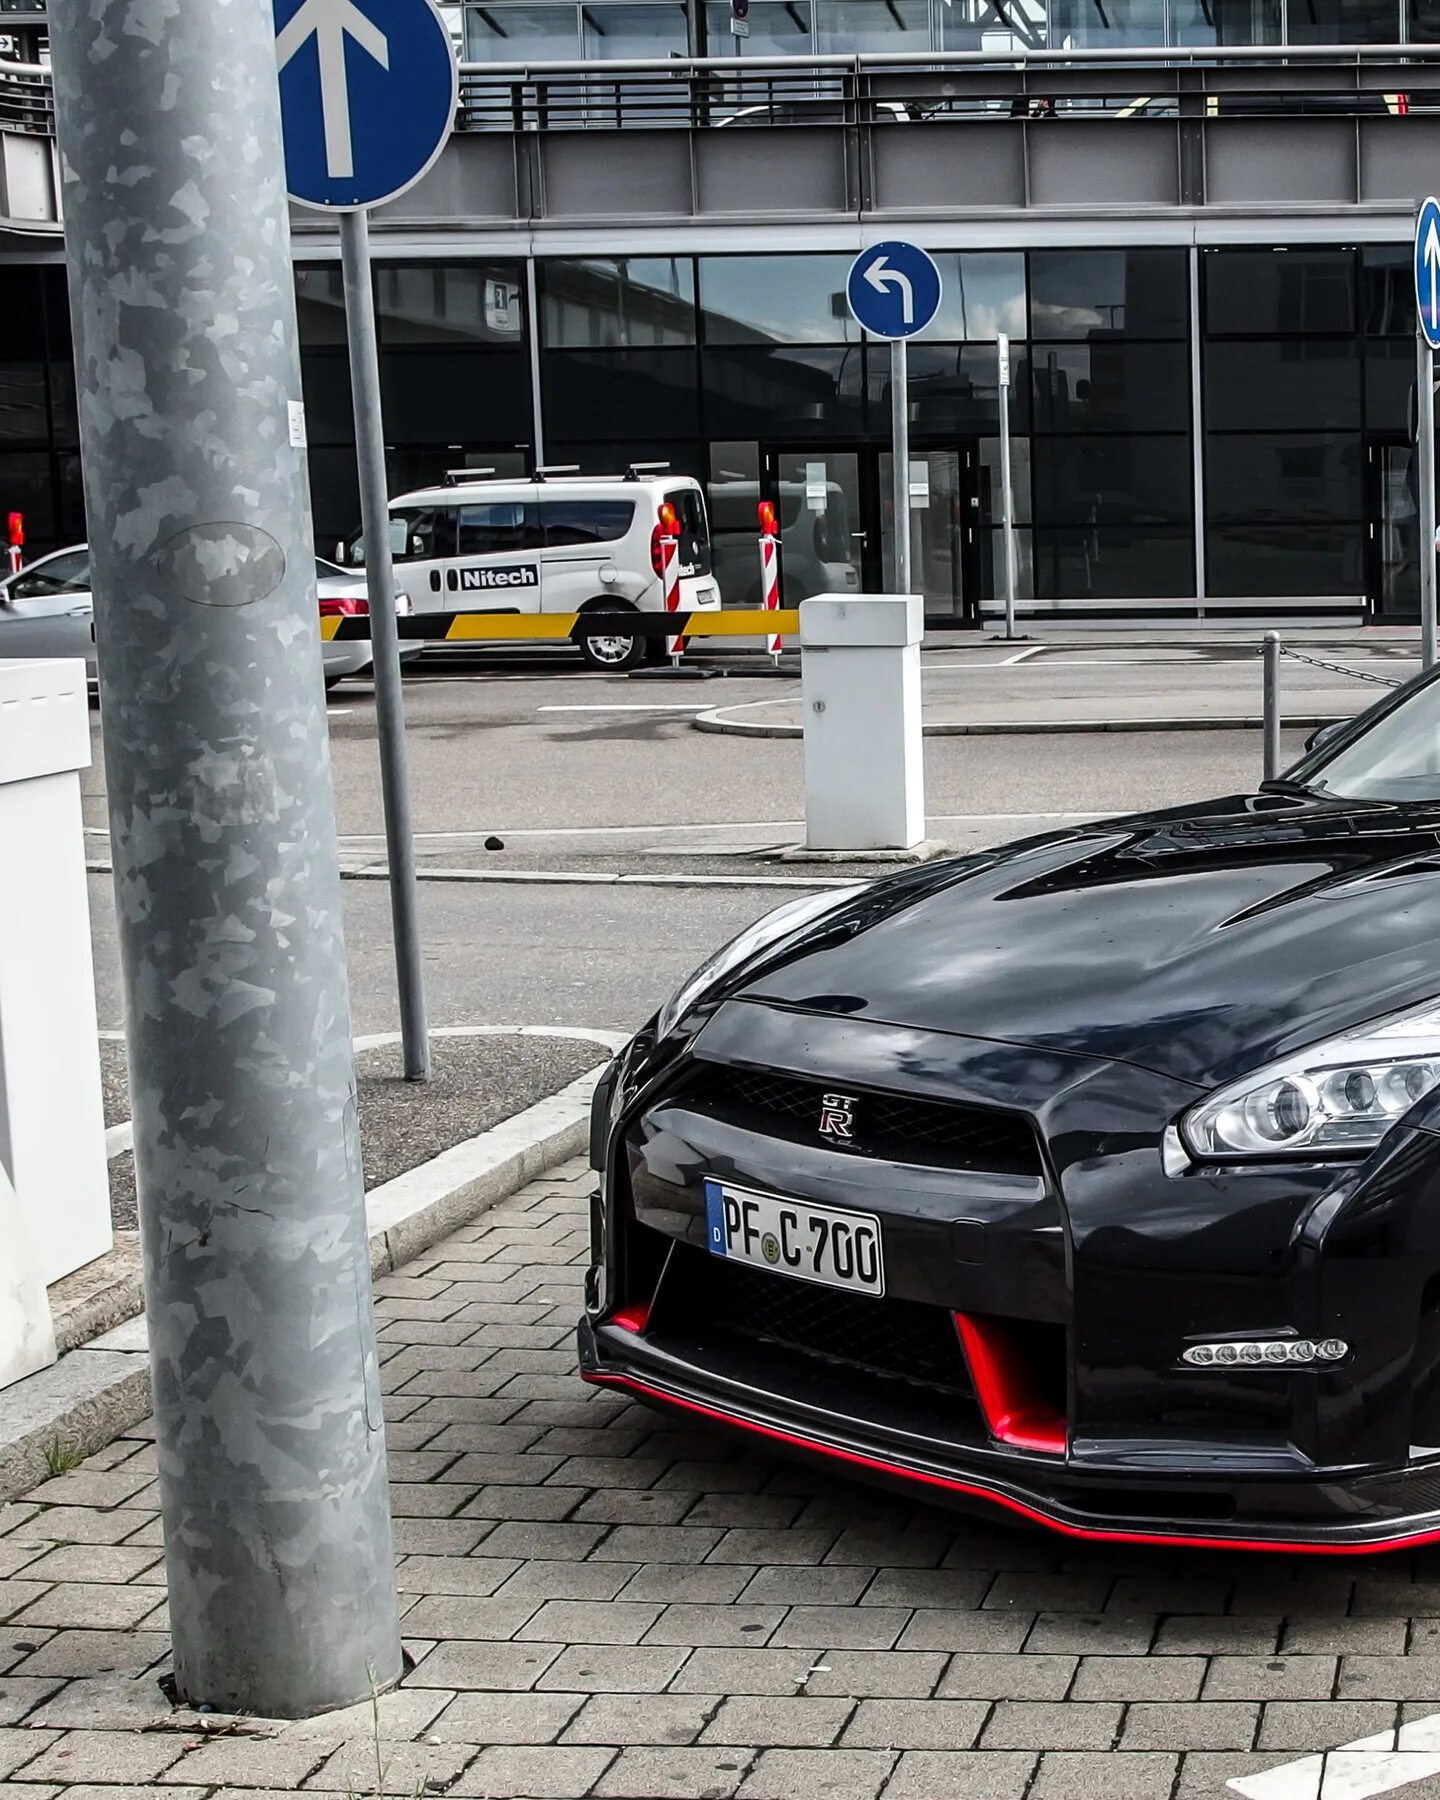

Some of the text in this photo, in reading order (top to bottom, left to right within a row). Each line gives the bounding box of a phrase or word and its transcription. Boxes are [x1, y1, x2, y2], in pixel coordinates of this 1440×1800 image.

[463, 567, 535, 588] Nitech
[713, 1227, 721, 1242] D
[723, 1195, 760, 1255] PF
[809, 1216, 877, 1283] 700
